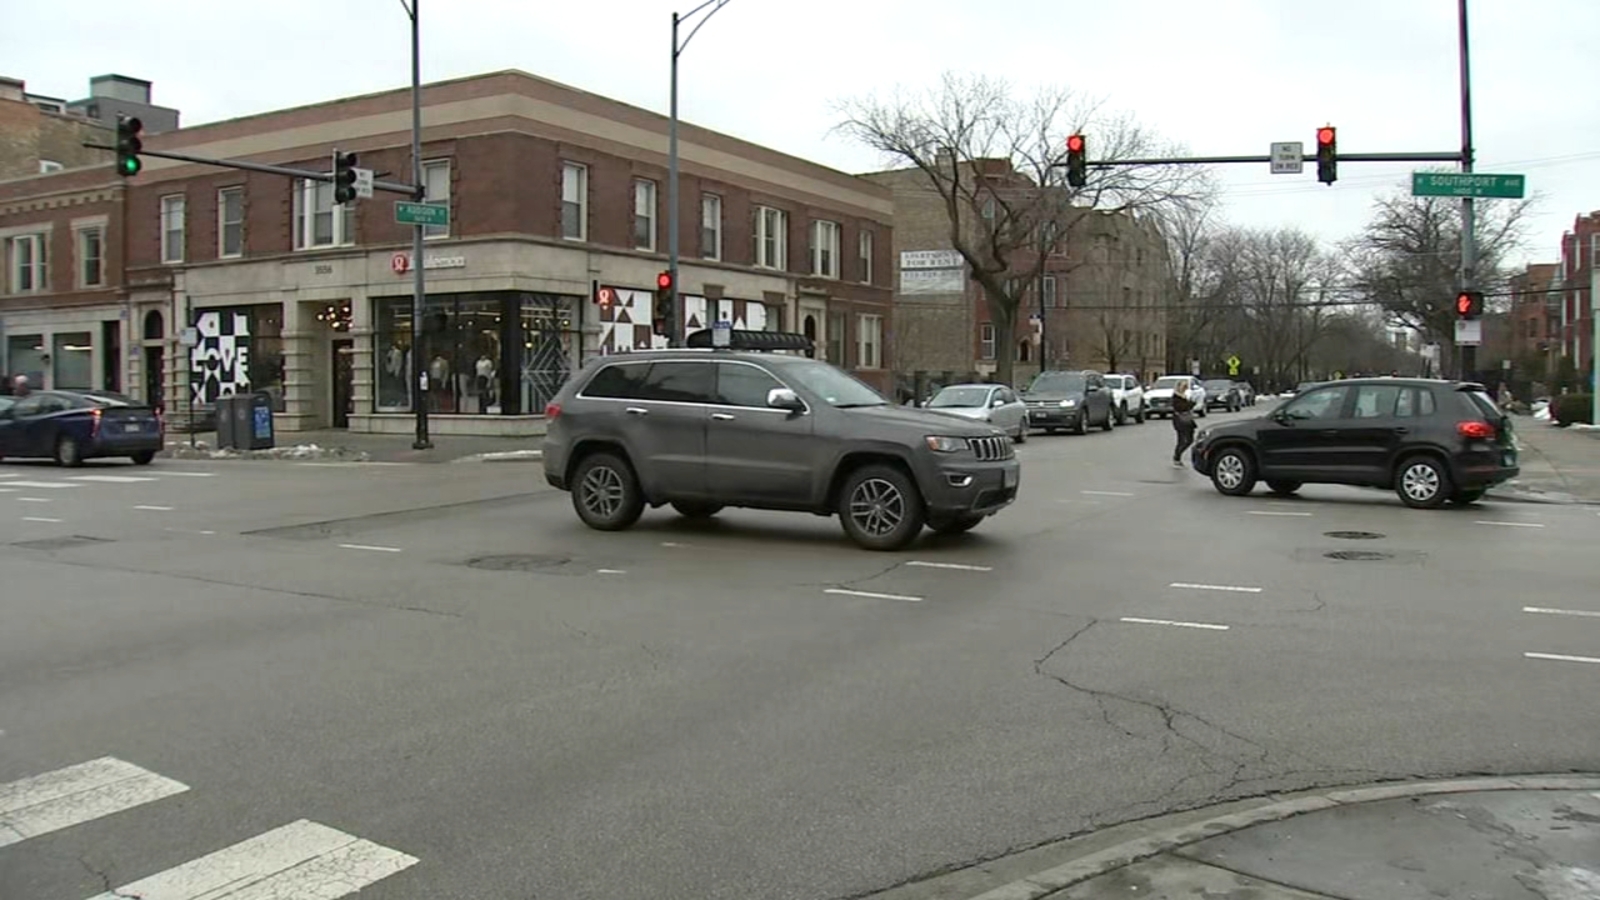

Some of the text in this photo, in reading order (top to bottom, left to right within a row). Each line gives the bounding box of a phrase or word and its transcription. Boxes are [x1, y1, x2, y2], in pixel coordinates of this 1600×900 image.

[1430, 174, 1498, 187] SOUTHPORT
[905, 258, 960, 267] FOR RENT
